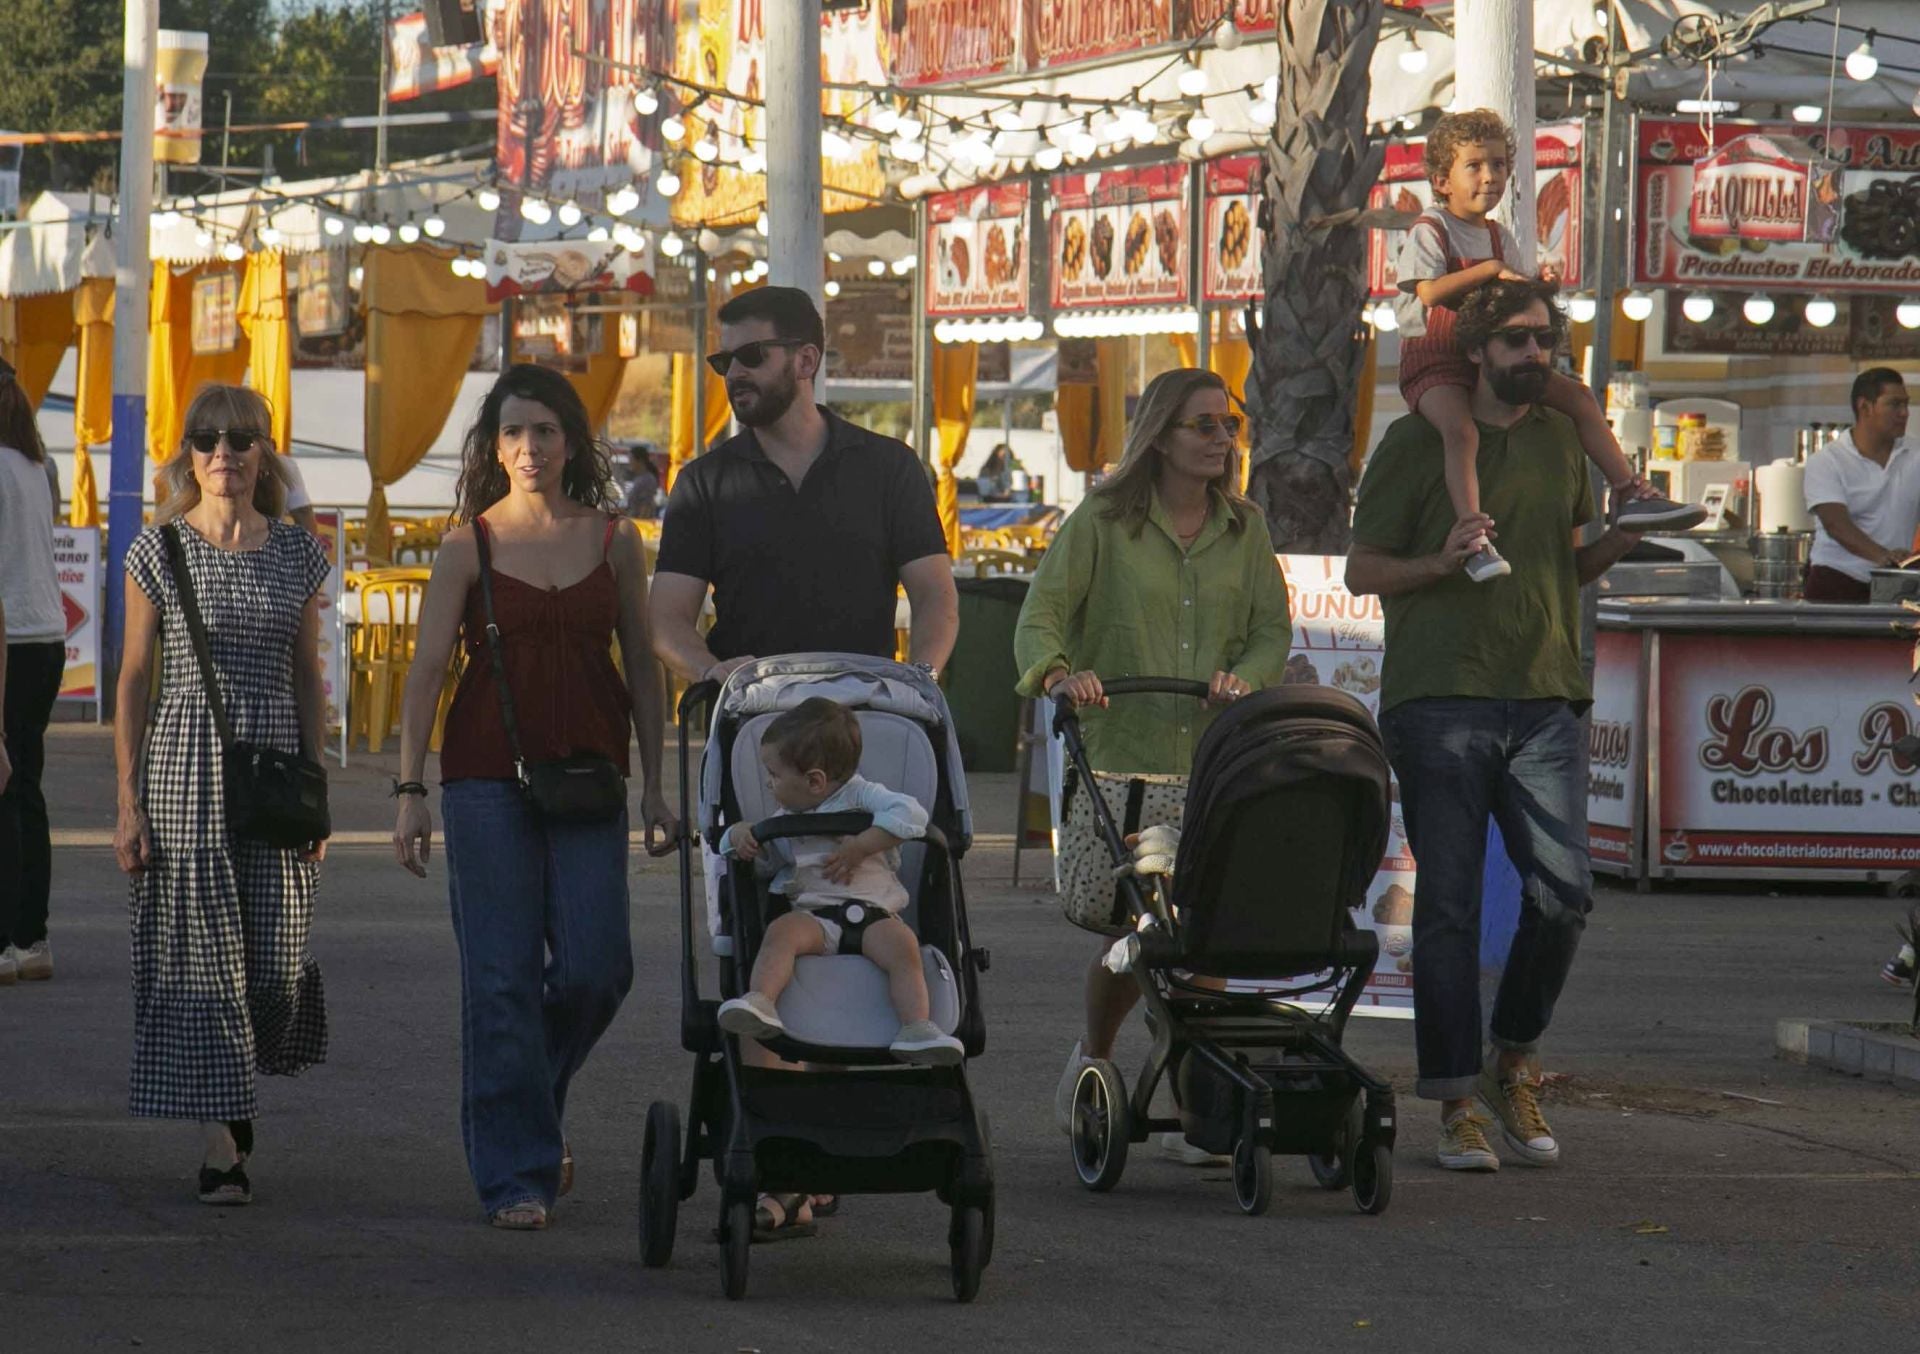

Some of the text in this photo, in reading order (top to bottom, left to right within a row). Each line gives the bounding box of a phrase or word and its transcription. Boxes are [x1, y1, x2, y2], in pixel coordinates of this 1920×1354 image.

[1696, 175, 1802, 231] TAQUILLA
[1679, 255, 1800, 277] Productos
[1699, 685, 1828, 776] Los
[1711, 778, 1864, 807] Chocolaterias
